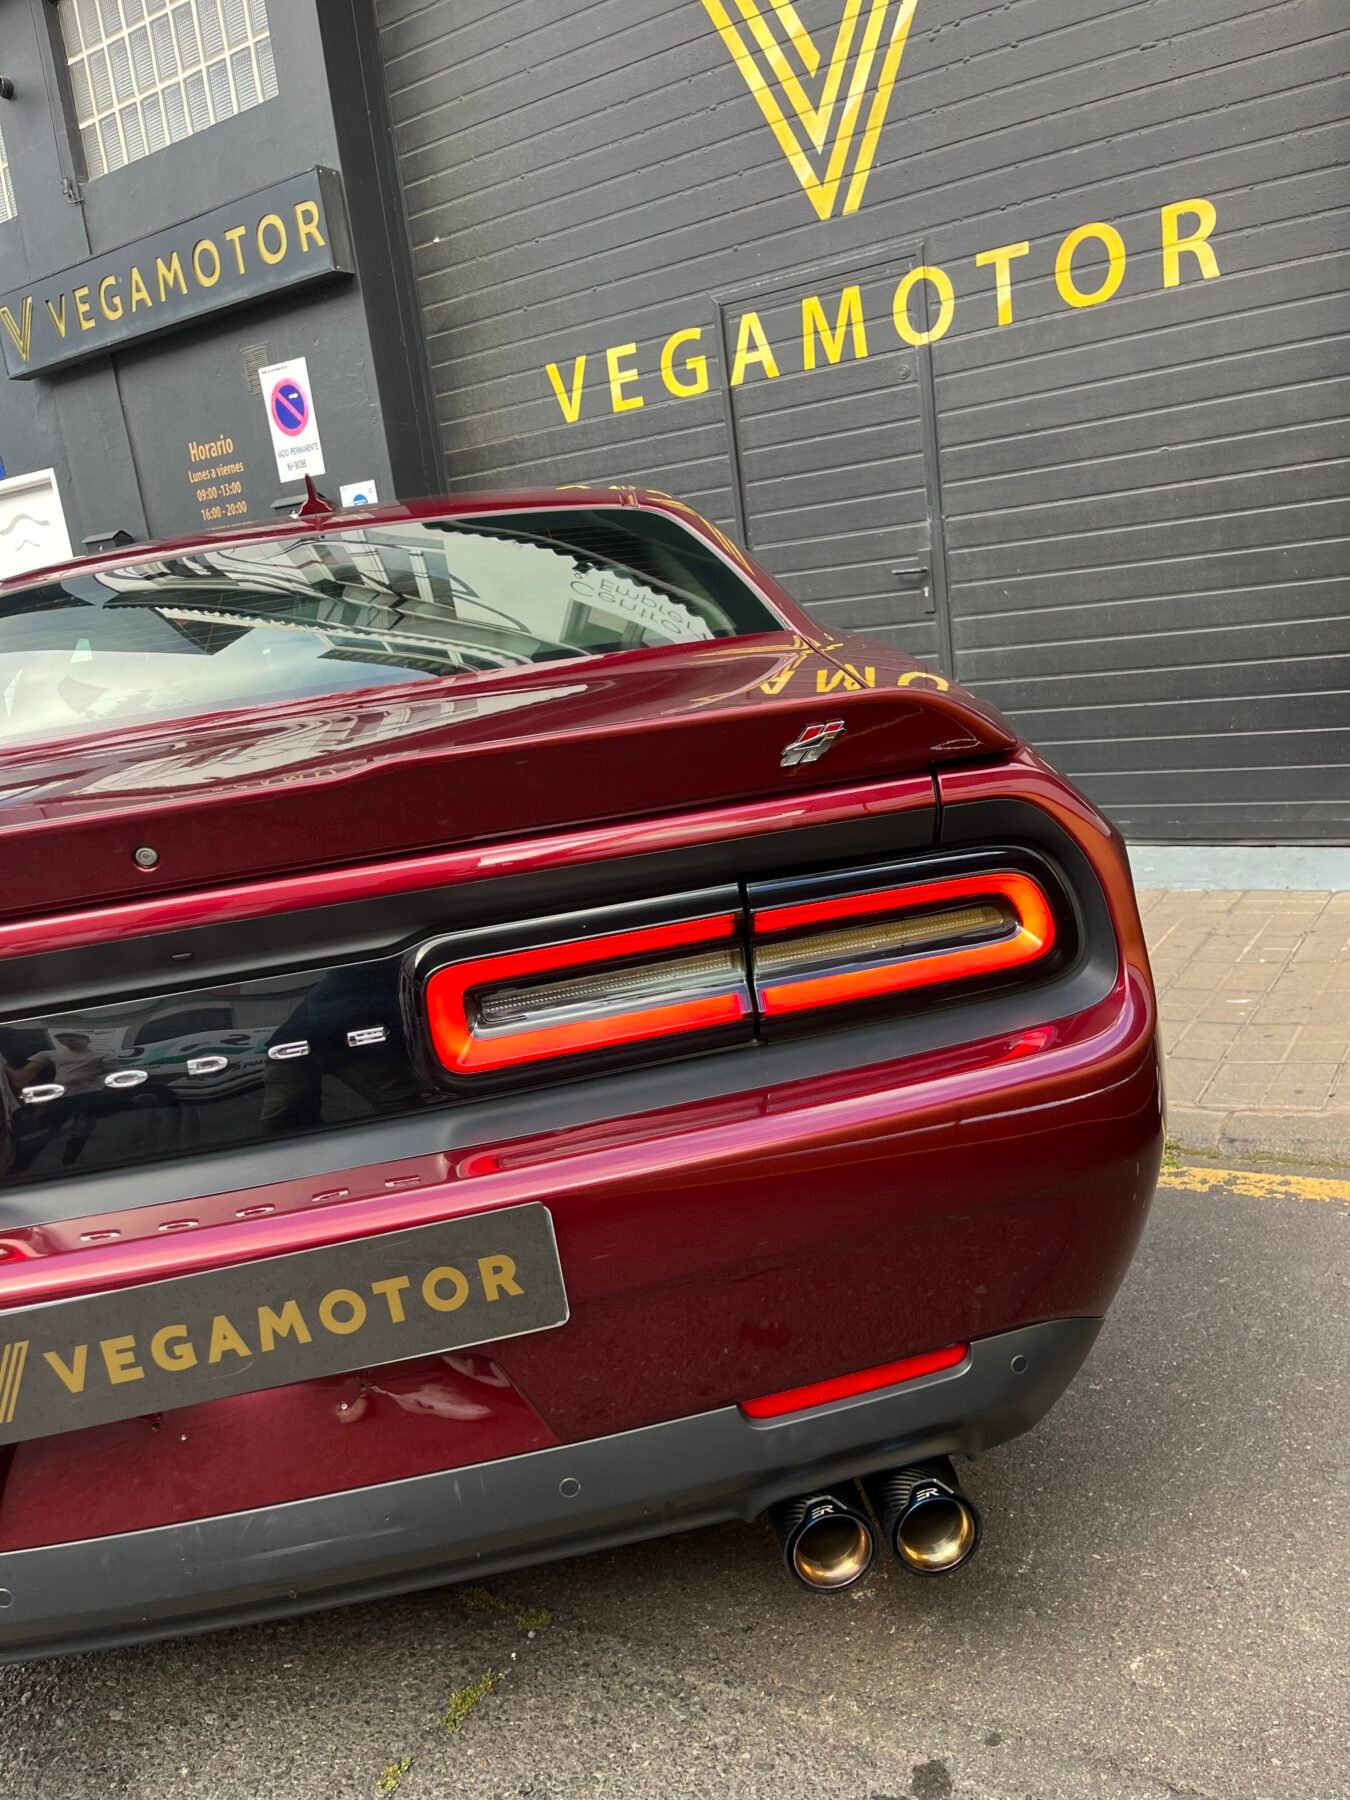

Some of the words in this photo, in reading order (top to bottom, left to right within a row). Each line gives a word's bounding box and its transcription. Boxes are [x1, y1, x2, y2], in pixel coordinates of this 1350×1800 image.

[46, 200, 326, 337] VEGAMOTOR
[545, 198, 1221, 424] VEGAMOTOR
[188, 433, 234, 462] Horario
[290, 442, 319, 456] PERMANENTE
[188, 470, 211, 483] Lunes
[211, 468, 217, 478] a
[216, 462, 244, 478] viernes
[196, 486, 218, 502] 09:00
[201, 505, 222, 521] 16:00
[226, 500, 247, 516] 20:00
[20, 1026, 387, 1103] DODGE
[43, 1254, 524, 1395] VEGAMOTOR
